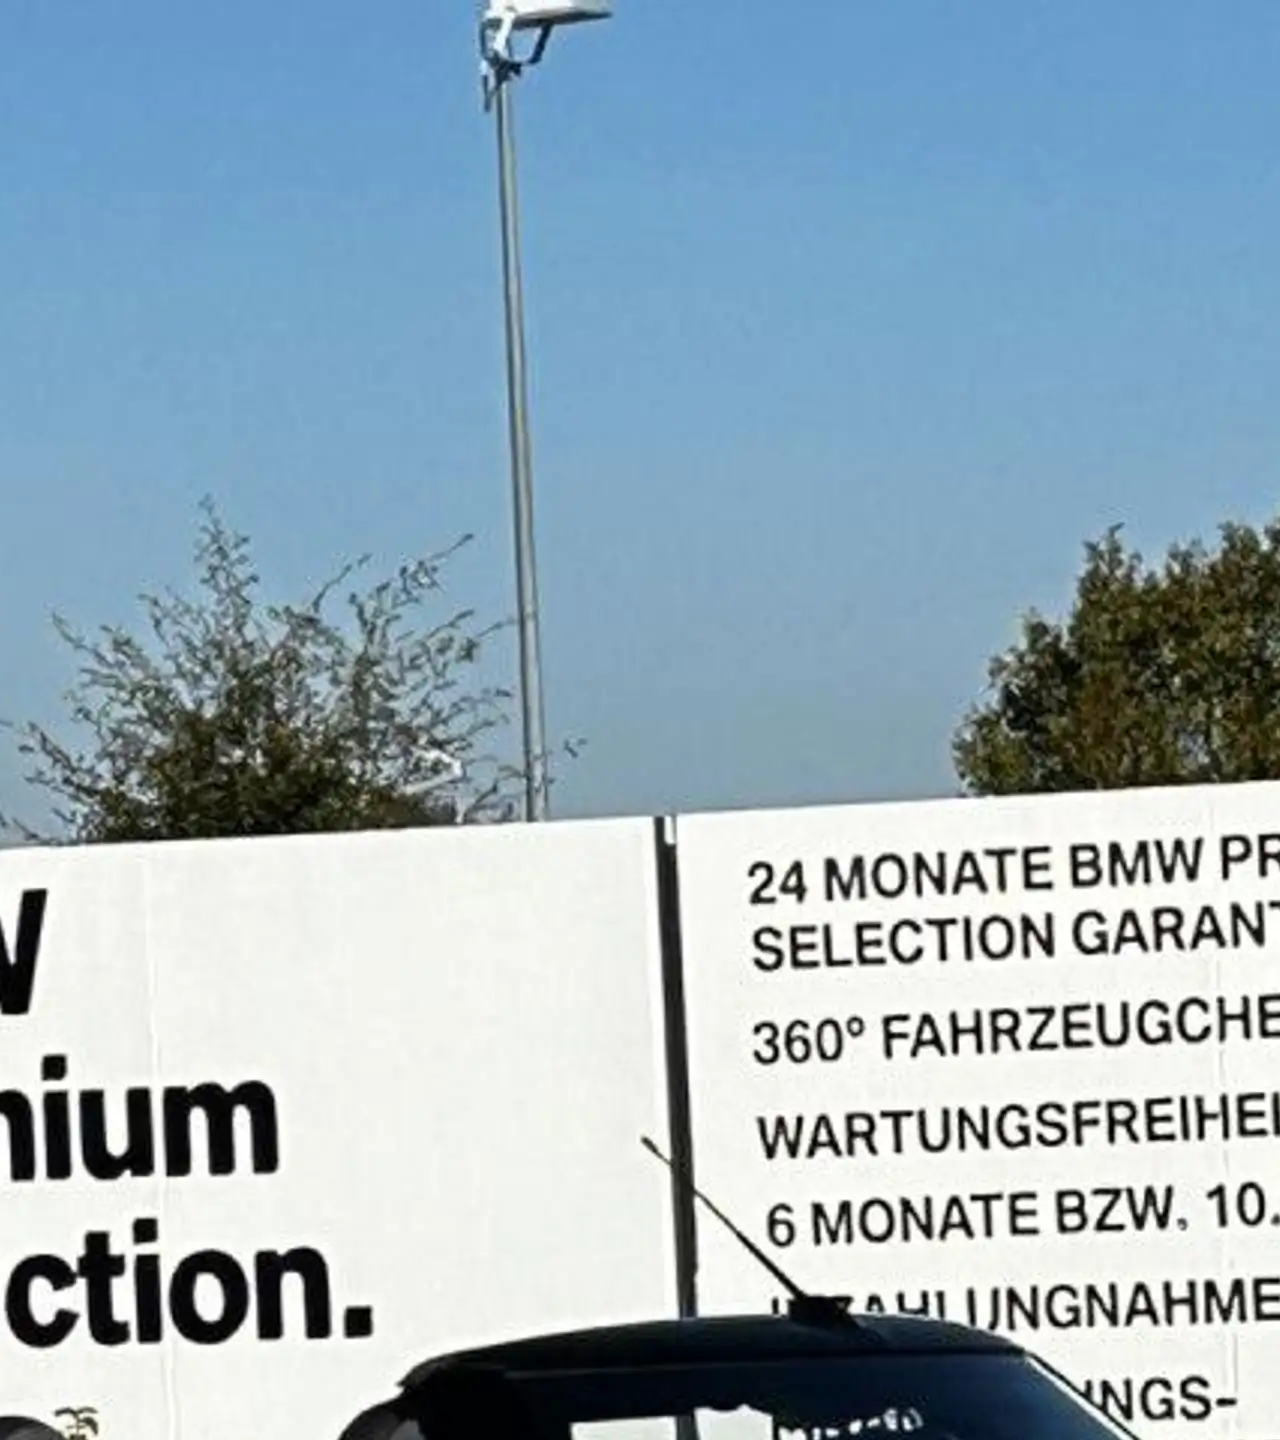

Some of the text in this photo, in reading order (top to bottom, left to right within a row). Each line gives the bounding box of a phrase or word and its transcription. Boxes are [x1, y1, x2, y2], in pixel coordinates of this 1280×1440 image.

[747, 859, 808, 906] 24
[824, 844, 1054, 902] MONATE
[1068, 836, 1204, 889] BMW
[752, 911, 1056, 973] SELECTION
[766, 1202, 796, 1249] 6
[810, 1190, 1041, 1247] MONATE
[1054, 1184, 1189, 1235] BZW.
